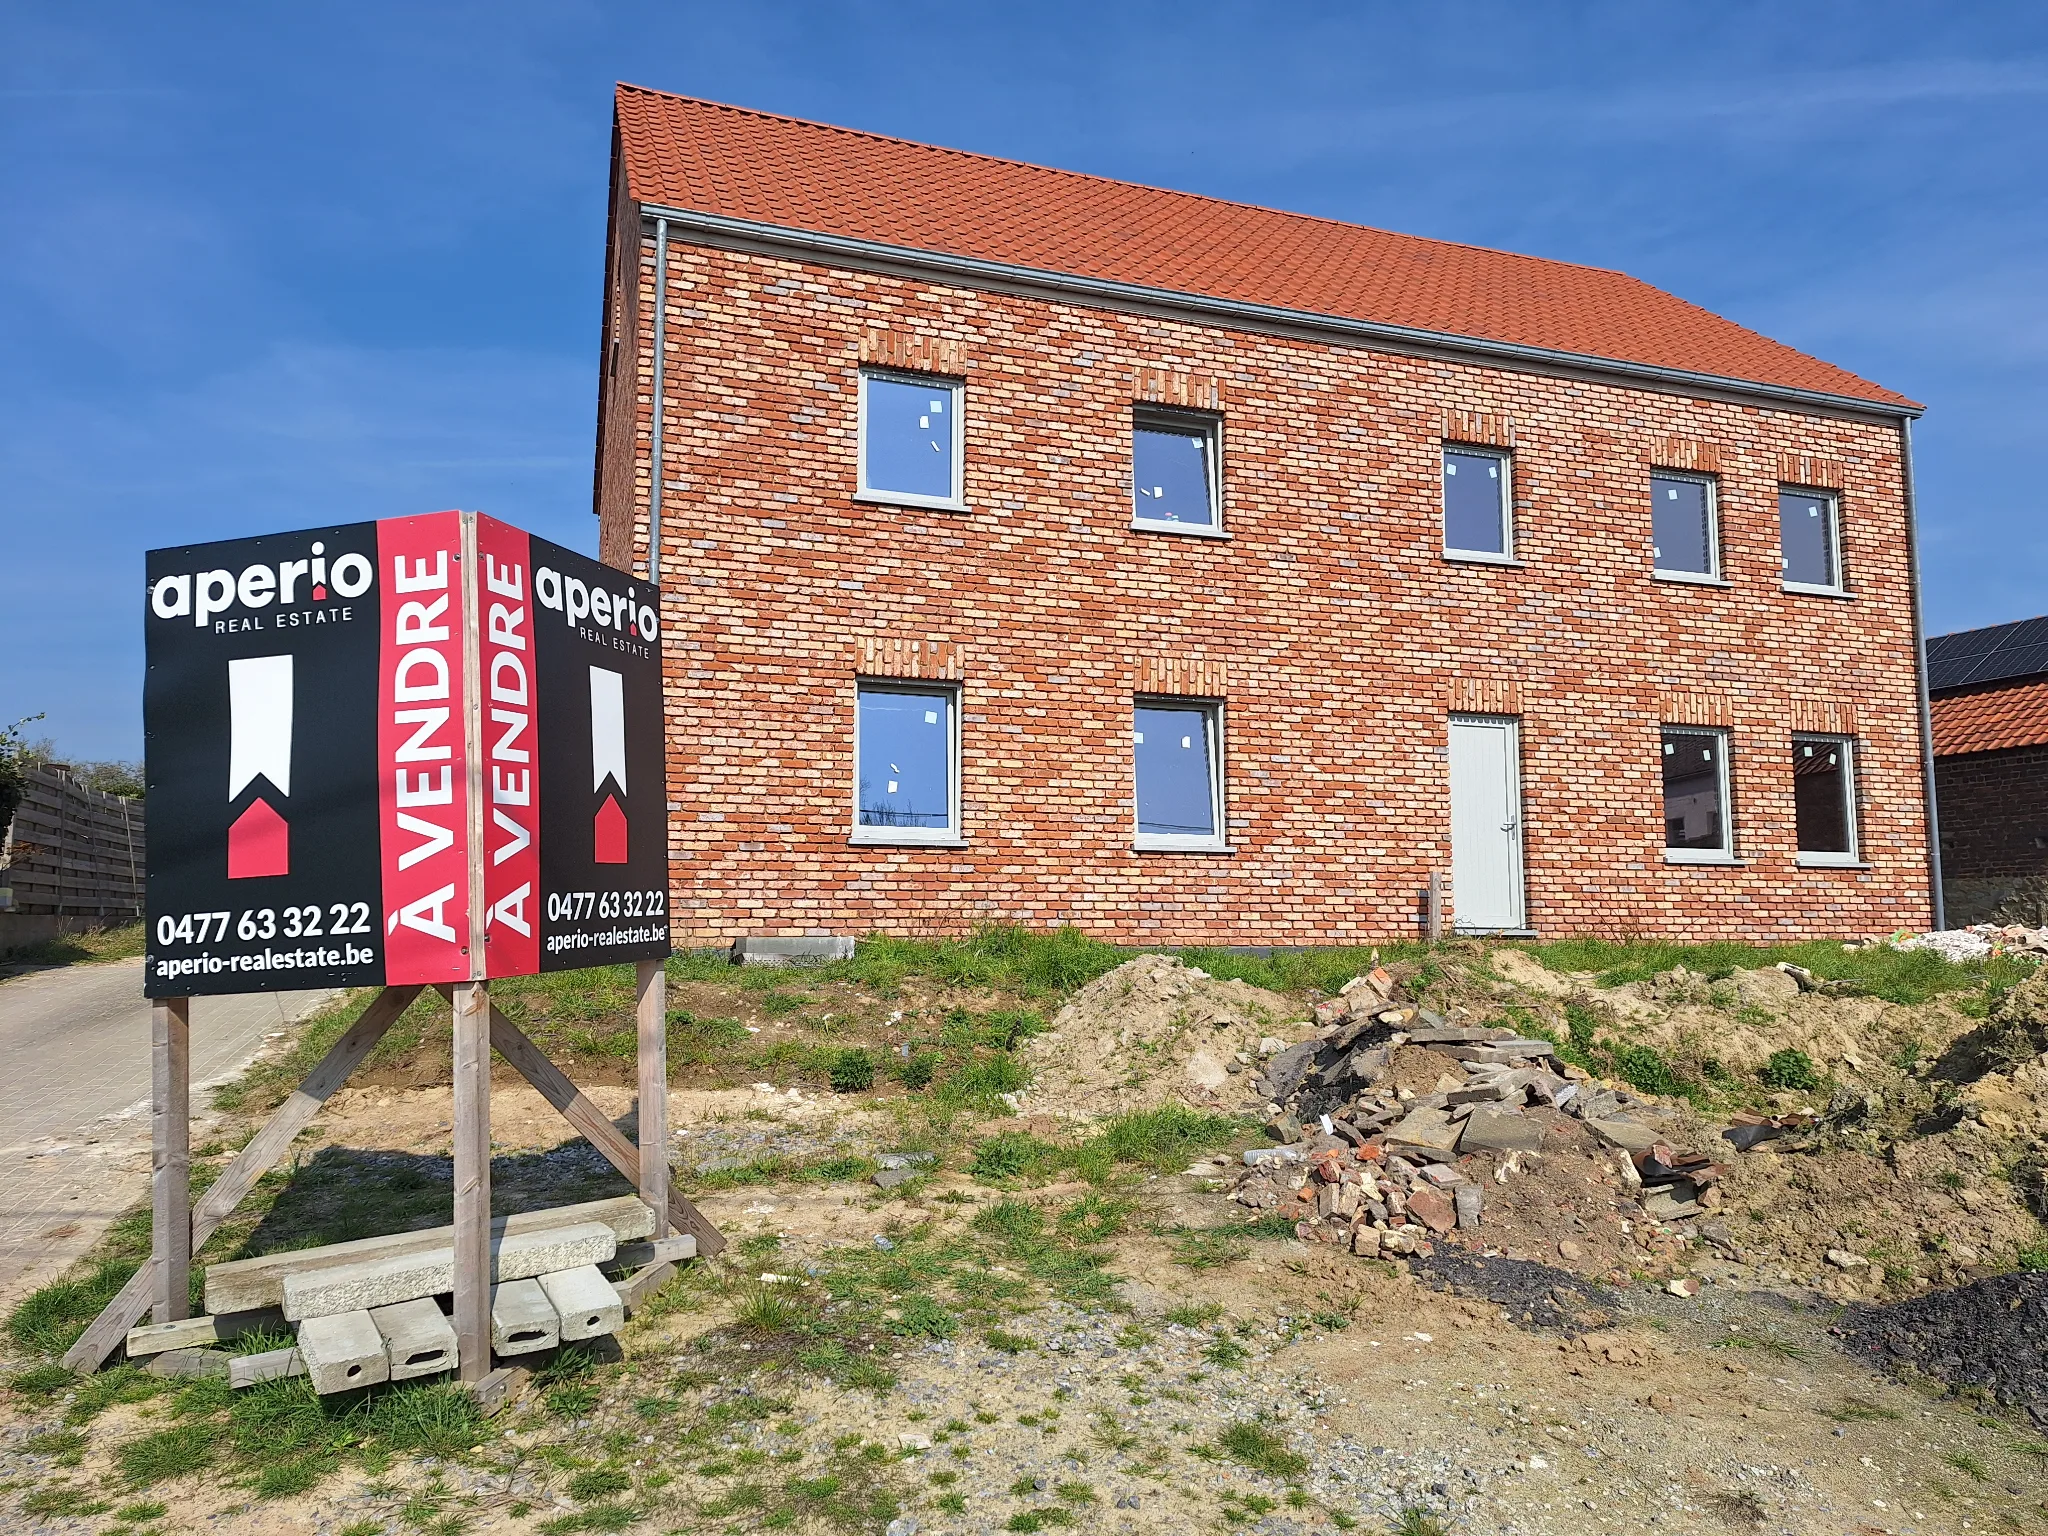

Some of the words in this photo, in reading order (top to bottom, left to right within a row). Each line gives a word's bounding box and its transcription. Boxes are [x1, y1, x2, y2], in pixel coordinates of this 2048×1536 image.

[150, 541, 373, 627] aperio
[535, 566, 658, 642] aperio
[215, 614, 264, 634] REAL
[276, 606, 353, 629] ESTATE
[579, 626, 608, 647] REAL
[613, 637, 650, 660] ESTATE
[393, 549, 454, 872] VENDRE
[485, 553, 531, 867] VENDRE
[156, 911, 231, 946] 0477
[237, 908, 277, 941] 63
[282, 904, 324, 938] 32
[329, 901, 371, 936] 22
[388, 882, 457, 944] À
[485, 880, 532, 939] À
[547, 892, 596, 922] 0477
[598, 891, 620, 919] 63
[623, 890, 643, 918] 32
[645, 890, 665, 917] 22
[156, 942, 374, 980] aperio-realestate.be
[546, 923, 666, 955] aperio-realestate.be
